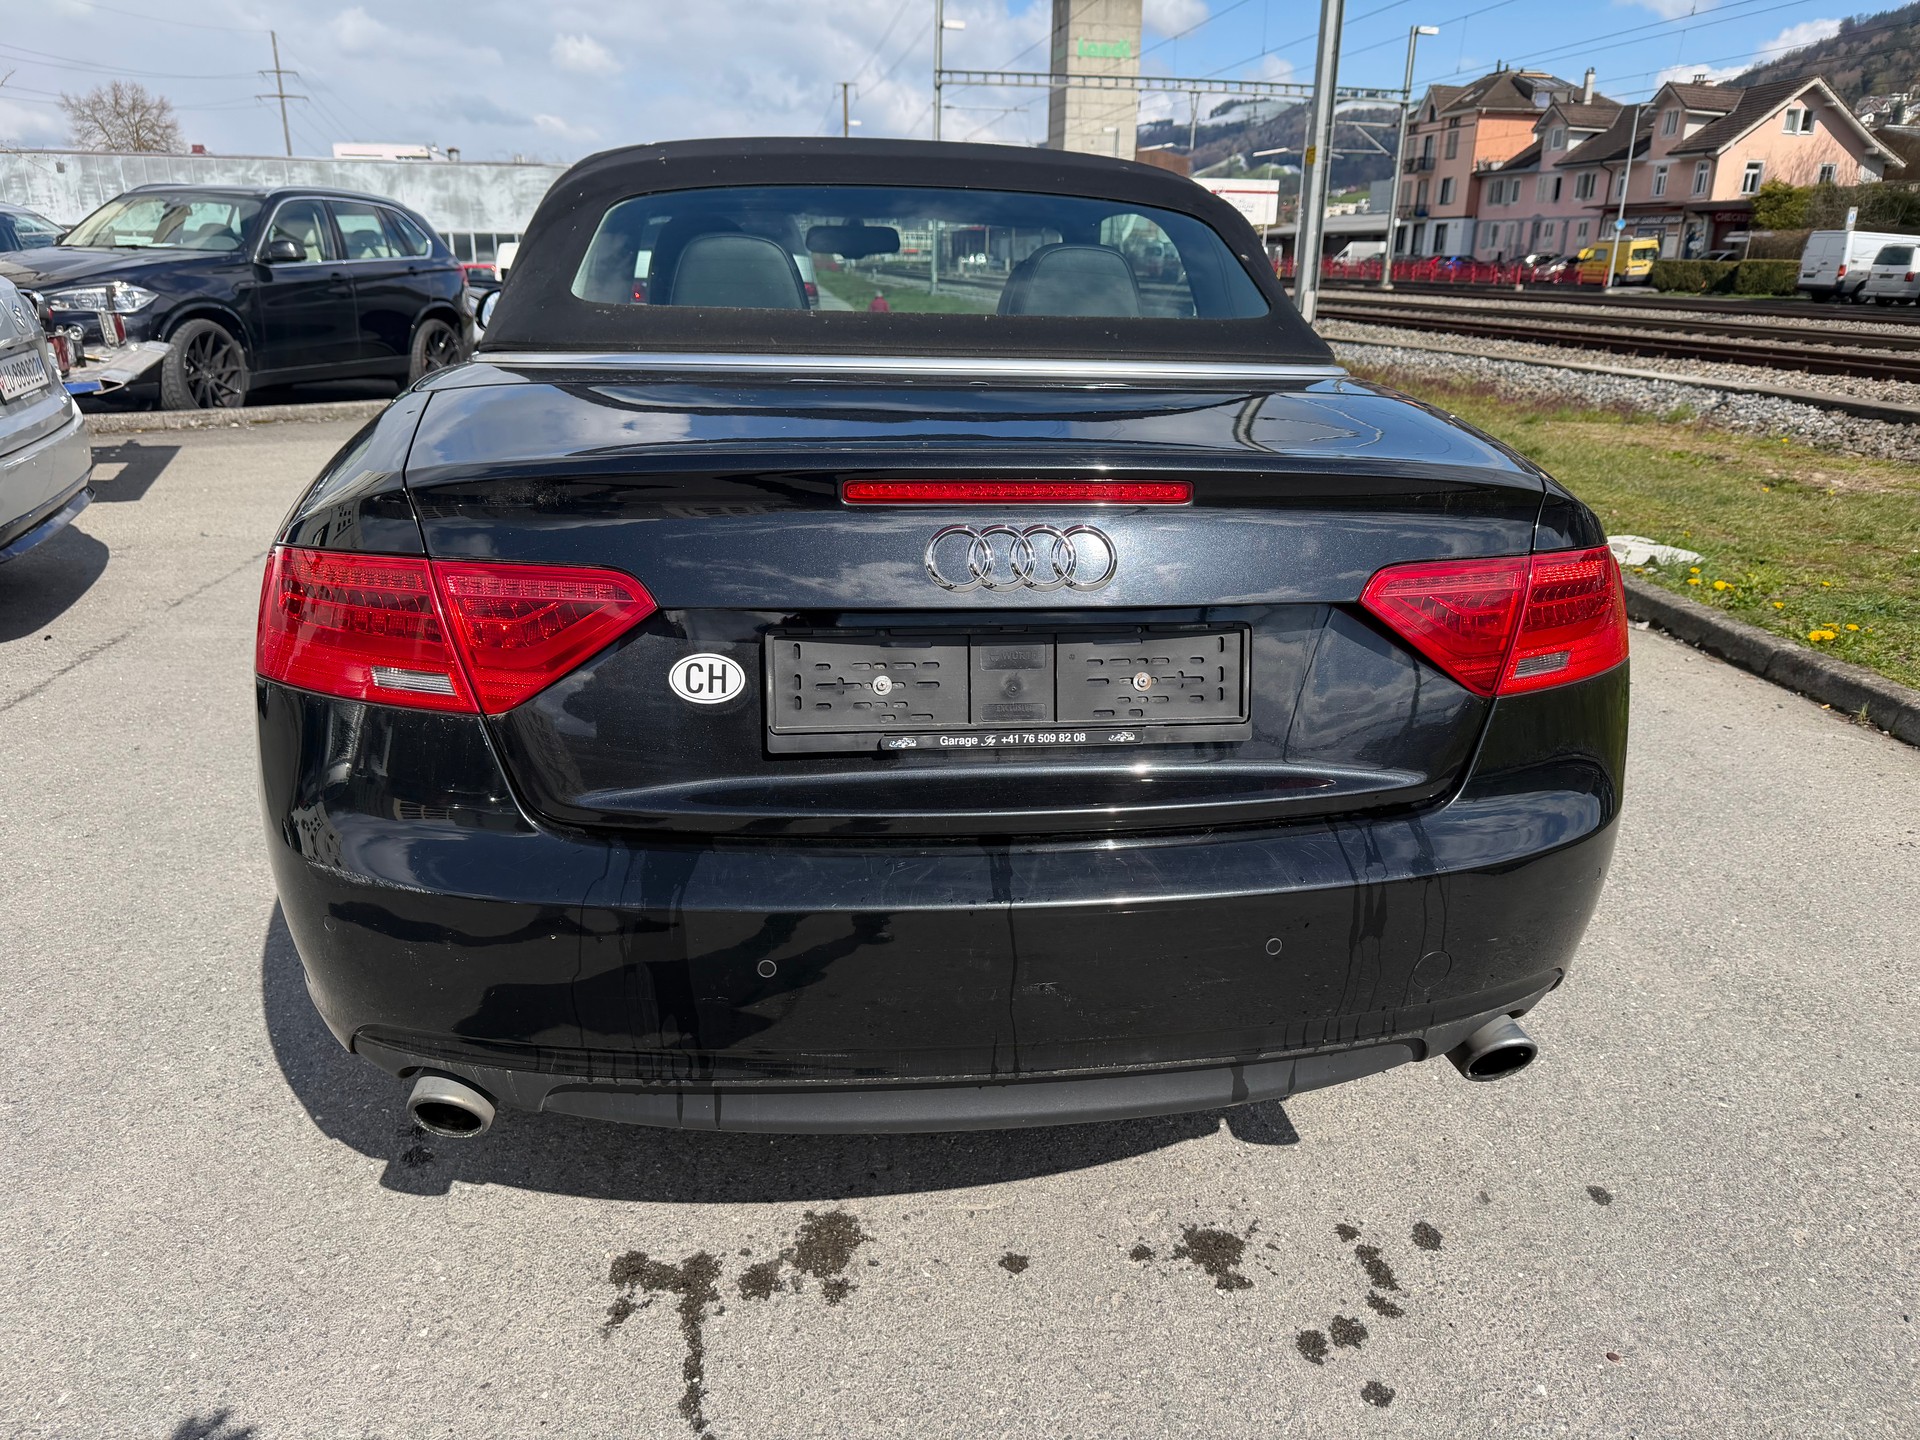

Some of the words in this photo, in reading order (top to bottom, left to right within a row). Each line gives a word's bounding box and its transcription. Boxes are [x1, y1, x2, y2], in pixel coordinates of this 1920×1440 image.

[685, 663, 726, 694] CH
[940, 736, 978, 747] Garage
[1001, 735, 1019, 744] +41
[1023, 734, 1035, 743] 76
[1038, 733, 1056, 743] 509
[1059, 733, 1071, 742] 82
[1073, 732, 1086, 742] 08
